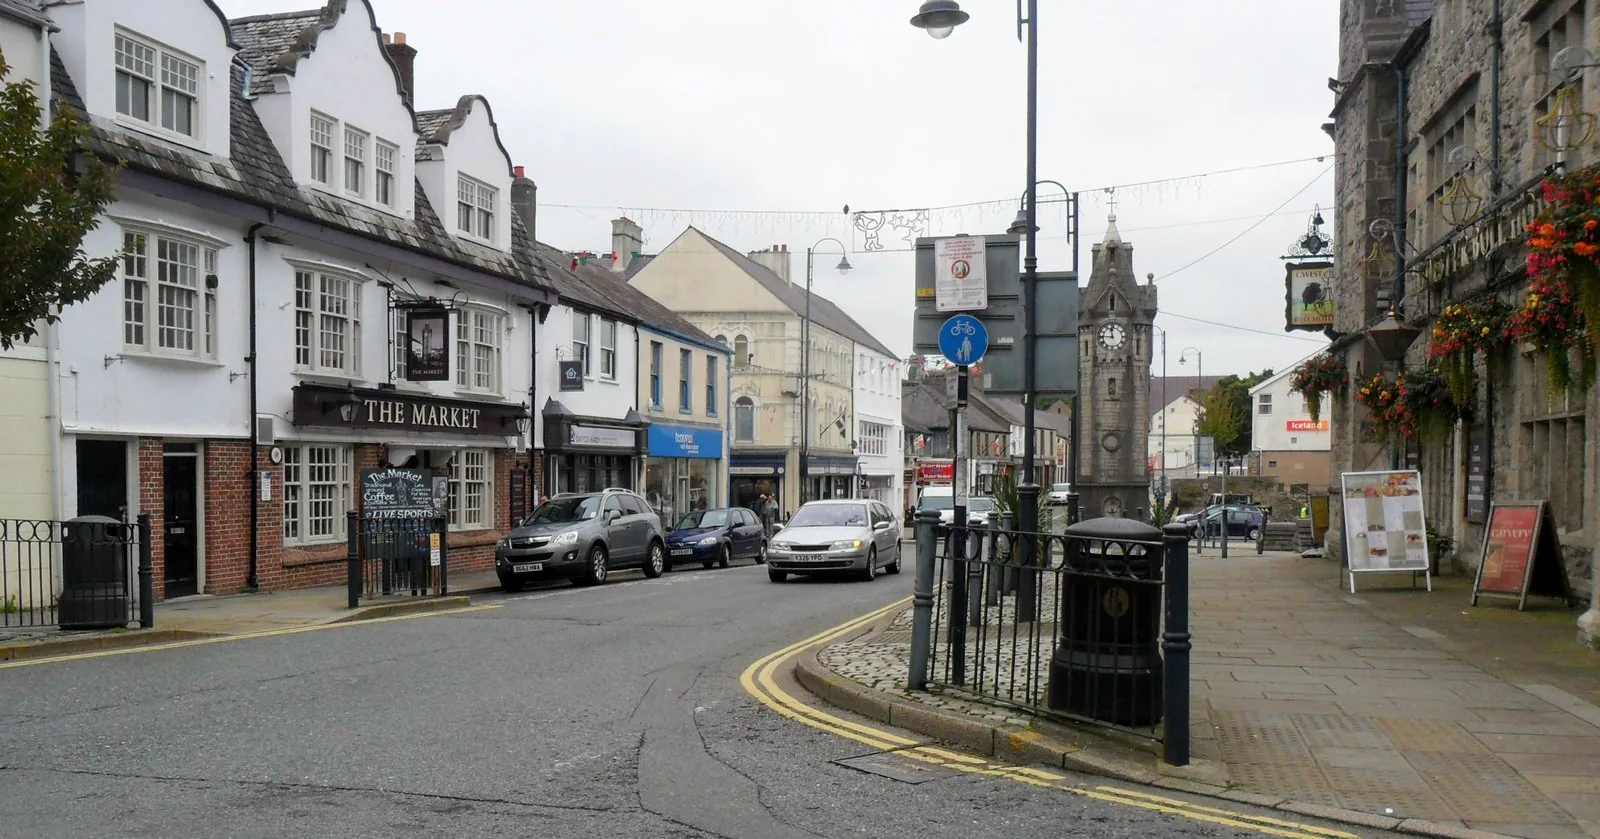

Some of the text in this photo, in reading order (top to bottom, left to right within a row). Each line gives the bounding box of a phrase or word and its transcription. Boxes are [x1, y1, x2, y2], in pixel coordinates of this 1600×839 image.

[364, 400, 480, 429] THE MARKET
[368, 469, 422, 482] The Market
[363, 492, 395, 501] Coffee
[372, 510, 396, 518] LIVE
[397, 509, 434, 518] SPORTS
